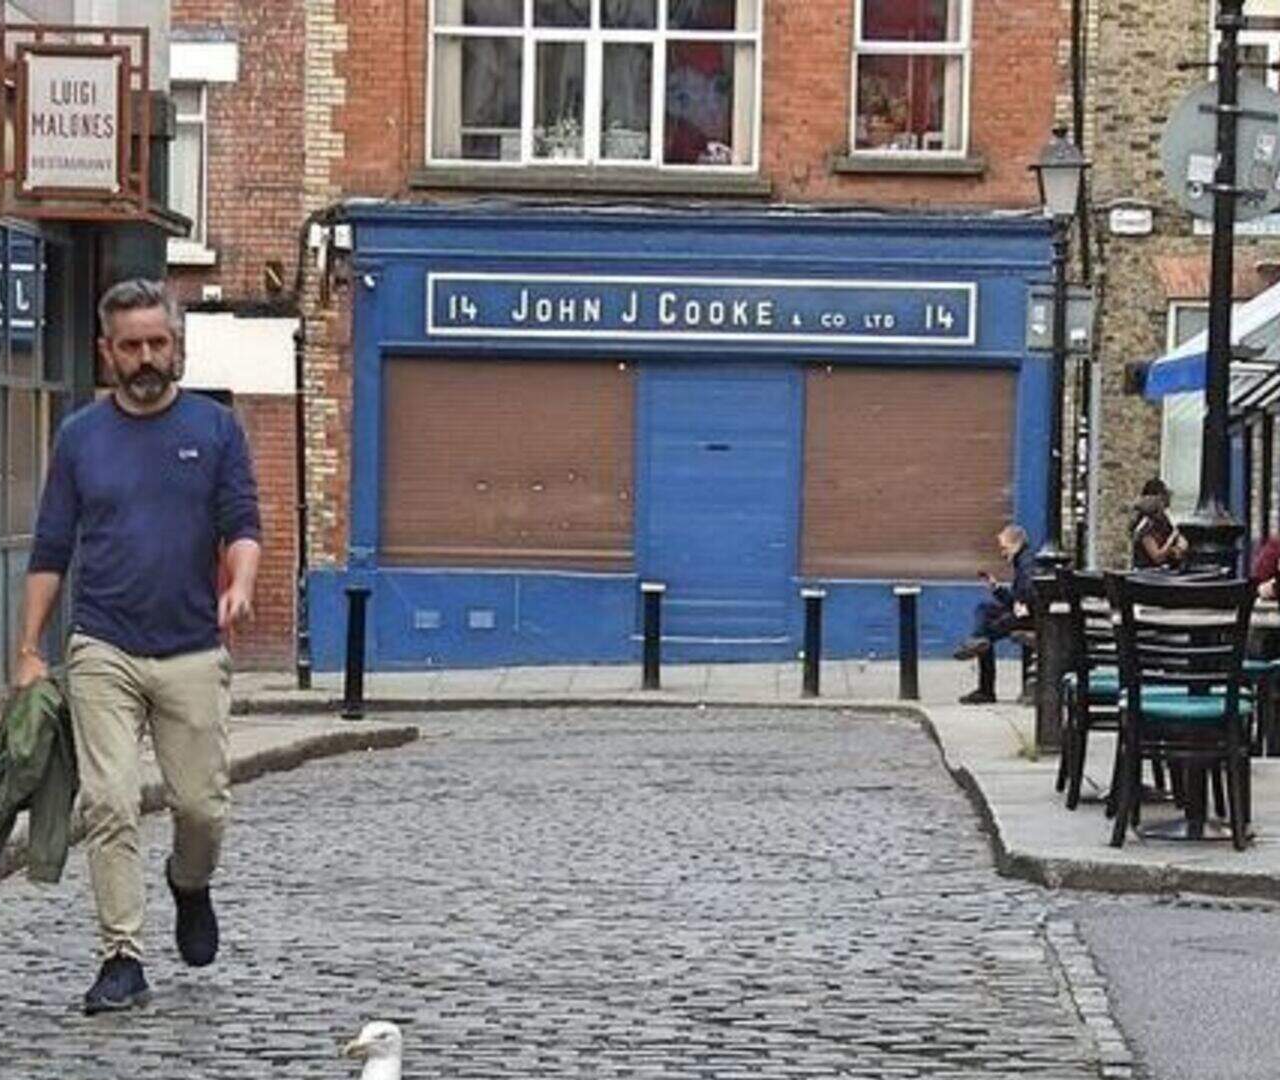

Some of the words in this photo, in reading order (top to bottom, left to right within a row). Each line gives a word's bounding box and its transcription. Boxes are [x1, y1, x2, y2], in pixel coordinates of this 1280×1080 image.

[50, 80, 97, 106] LUIGI
[30, 112, 115, 139] MALONES
[449, 295, 478, 321] 14
[512, 289, 601, 323] JOHN
[623, 290, 637, 323] J
[658, 291, 773, 326] COOKE
[821, 313, 847, 328] CO
[865, 314, 895, 328] LTD
[926, 304, 955, 329] 14
